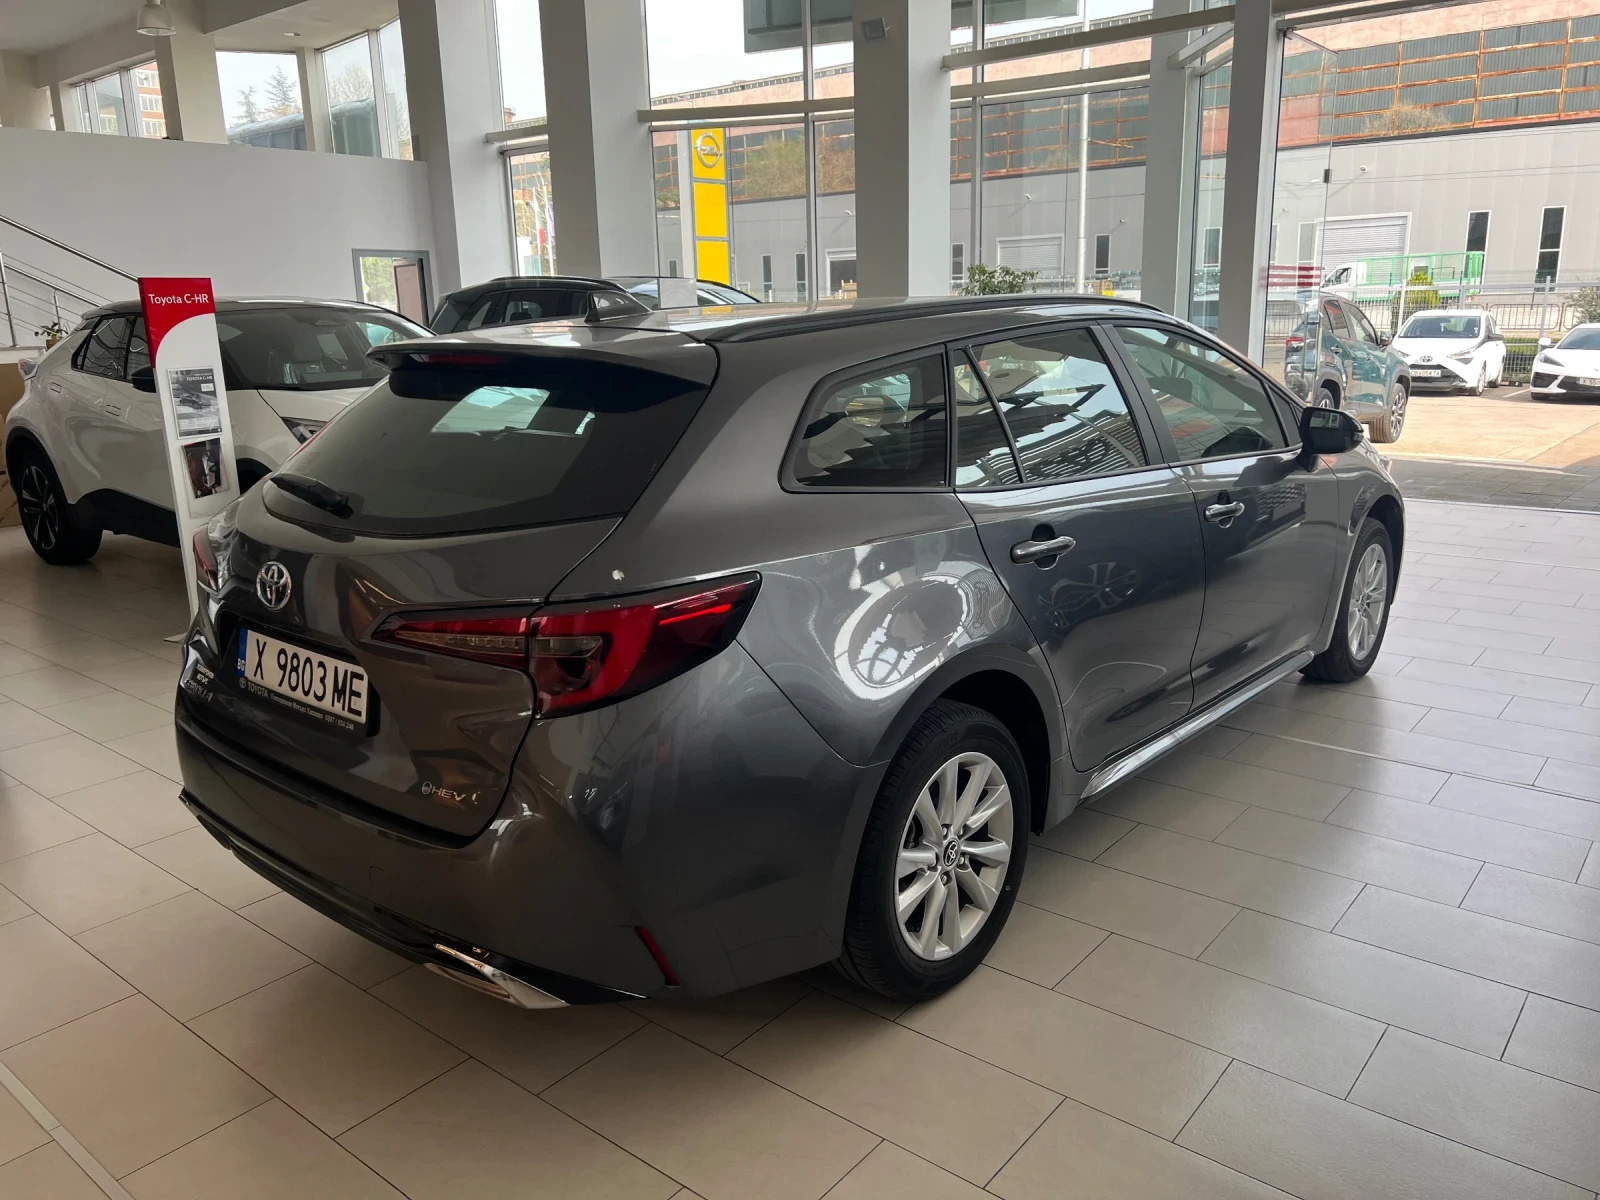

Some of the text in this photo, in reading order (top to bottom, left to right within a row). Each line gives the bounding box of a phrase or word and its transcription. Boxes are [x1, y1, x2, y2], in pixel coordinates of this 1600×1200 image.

[148, 293, 209, 306] Toyota C-HR
[237, 658, 246, 672] BG
[253, 638, 364, 717] X 9803 ME
[247, 681, 269, 699] TOYOTA
[431, 785, 467, 802] HEV
